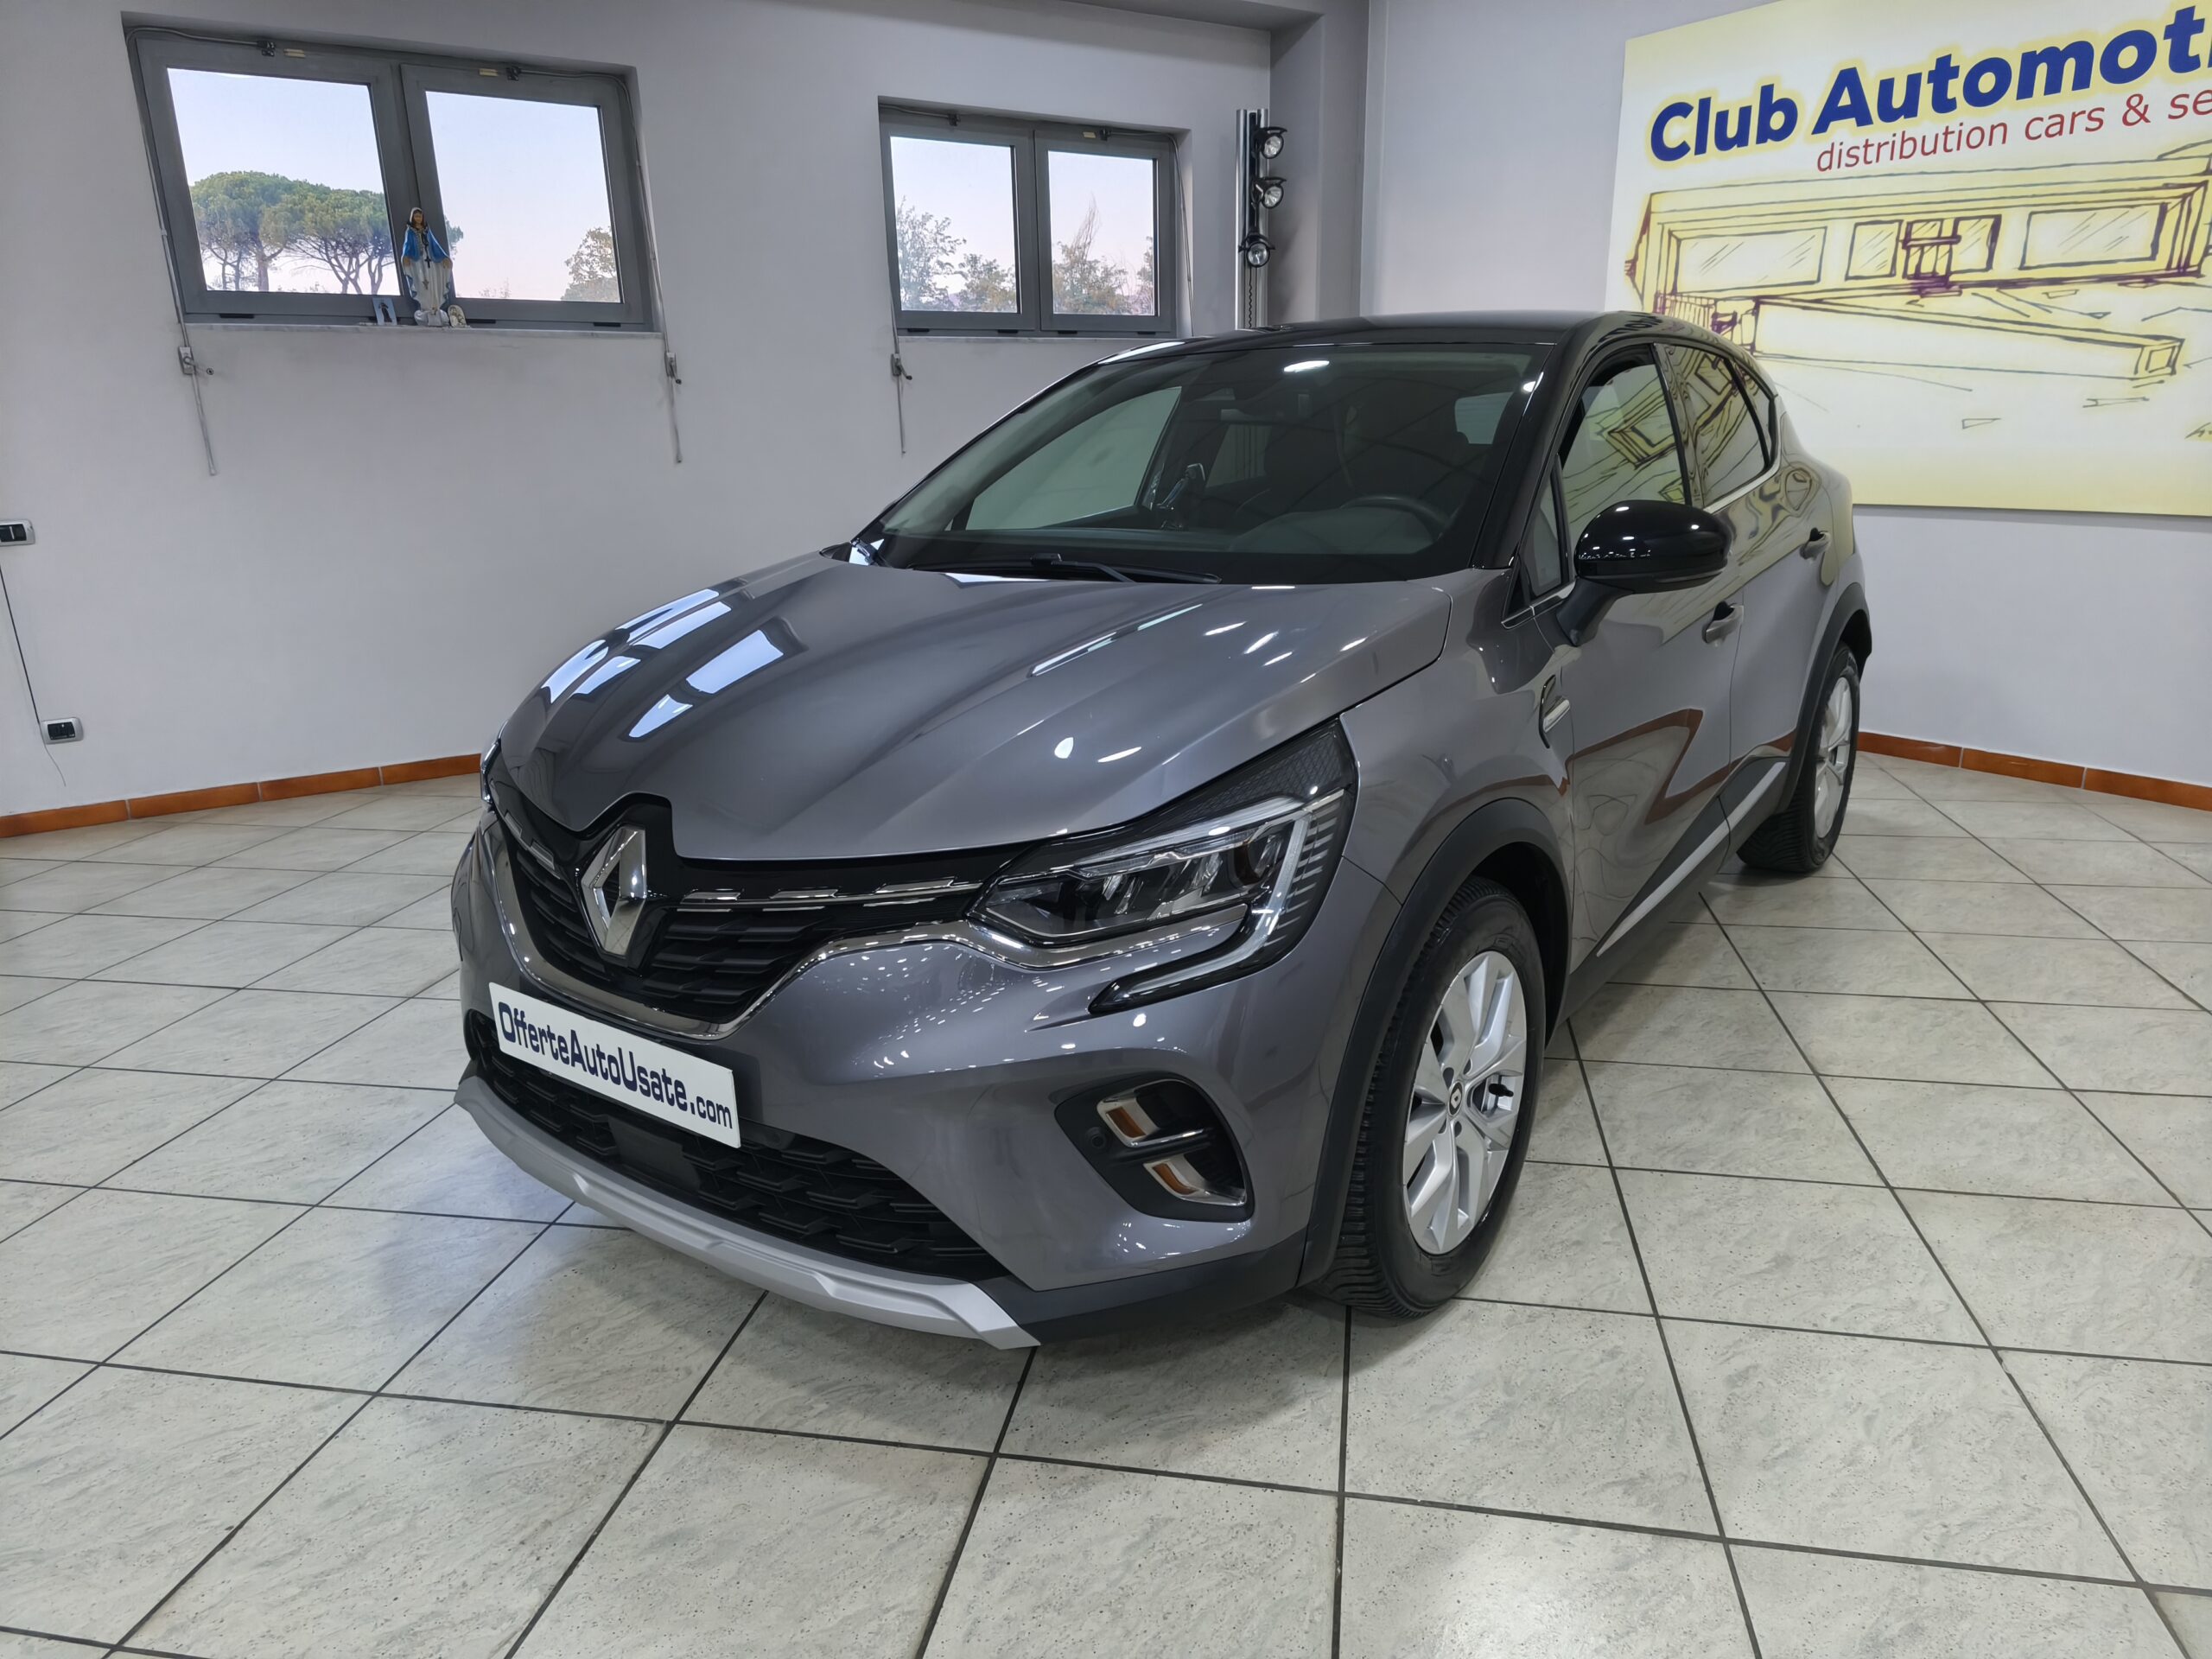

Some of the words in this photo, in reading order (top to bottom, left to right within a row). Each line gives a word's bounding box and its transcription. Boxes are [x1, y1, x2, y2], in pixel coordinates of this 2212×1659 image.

[1650, 84, 1799, 162] Club
[1811, 5, 2212, 135] Automot
[1816, 123, 2008, 172] distribution
[2024, 105, 2106, 141] cars
[2121, 92, 2152, 128] &
[498, 1001, 734, 1129] OfferteAutoUsate.com
